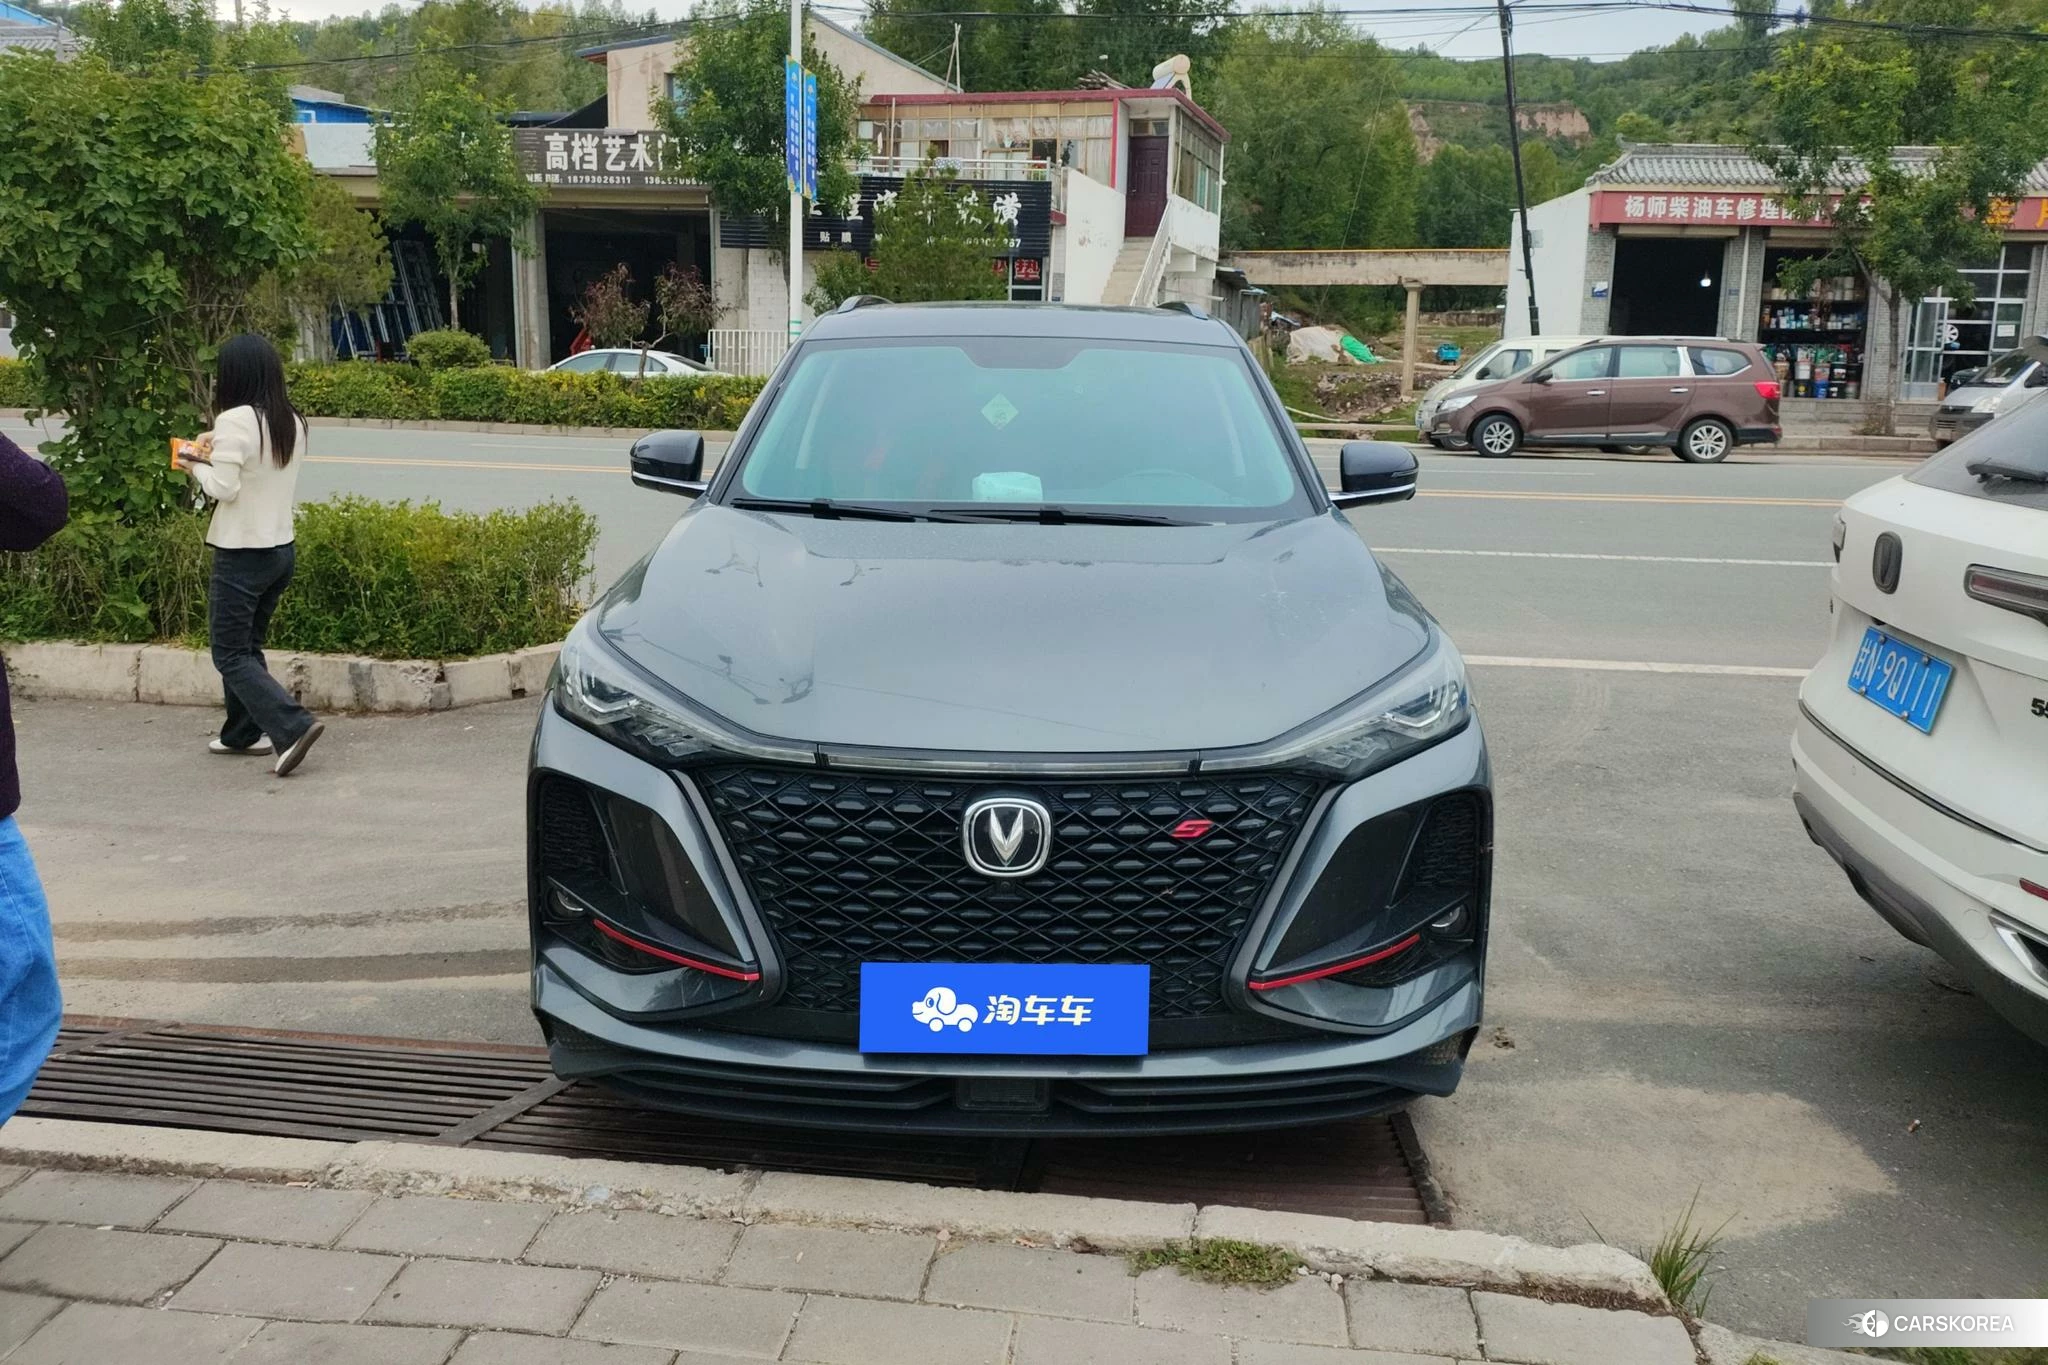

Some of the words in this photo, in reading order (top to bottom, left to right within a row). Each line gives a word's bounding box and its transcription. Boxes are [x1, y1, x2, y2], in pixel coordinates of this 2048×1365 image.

[544, 132, 707, 171] 高档艺术门
